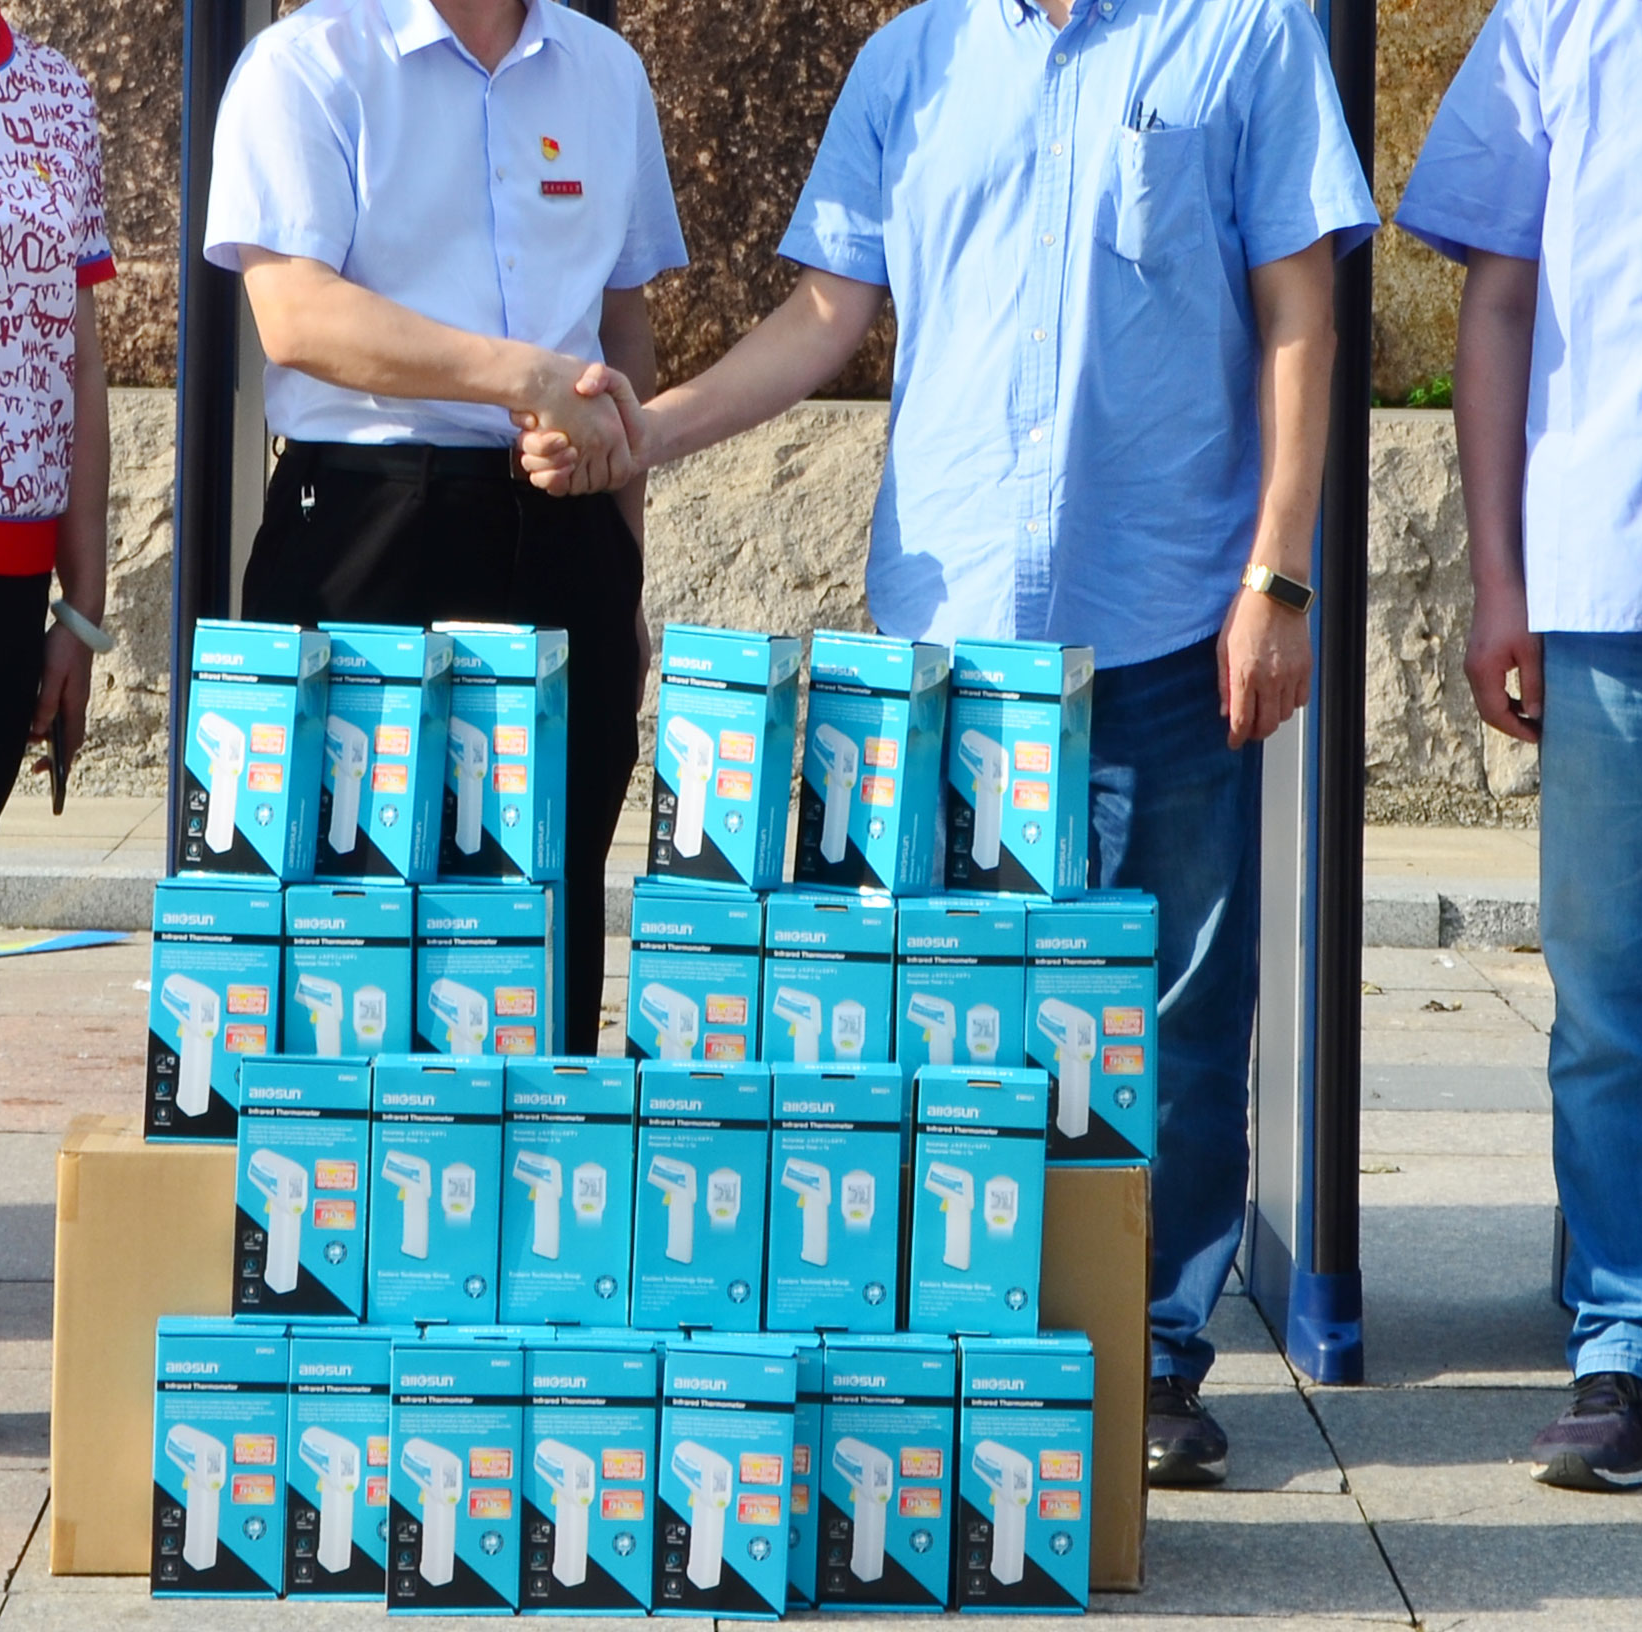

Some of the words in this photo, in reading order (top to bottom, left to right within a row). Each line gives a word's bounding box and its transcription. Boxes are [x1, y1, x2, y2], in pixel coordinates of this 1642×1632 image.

[189, 934, 232, 943] Thermometer
[321, 938, 364, 946] Thermometer
[668, 944, 711, 952] Thermometer
[802, 951, 845, 960] Thermometer
[276, 1109, 320, 1117] Thermometer
[542, 1114, 585, 1122] Thermometer
[677, 1119, 721, 1128] Thermometer
[810, 1122, 853, 1130] Thermometer
[954, 1127, 998, 1135] Thermometer
[193, 1383, 238, 1391] Thermometer
[429, 1396, 473, 1404] Thermometer
[561, 1397, 605, 1405] Thermometer
[701, 1400, 745, 1409] Thermometer
